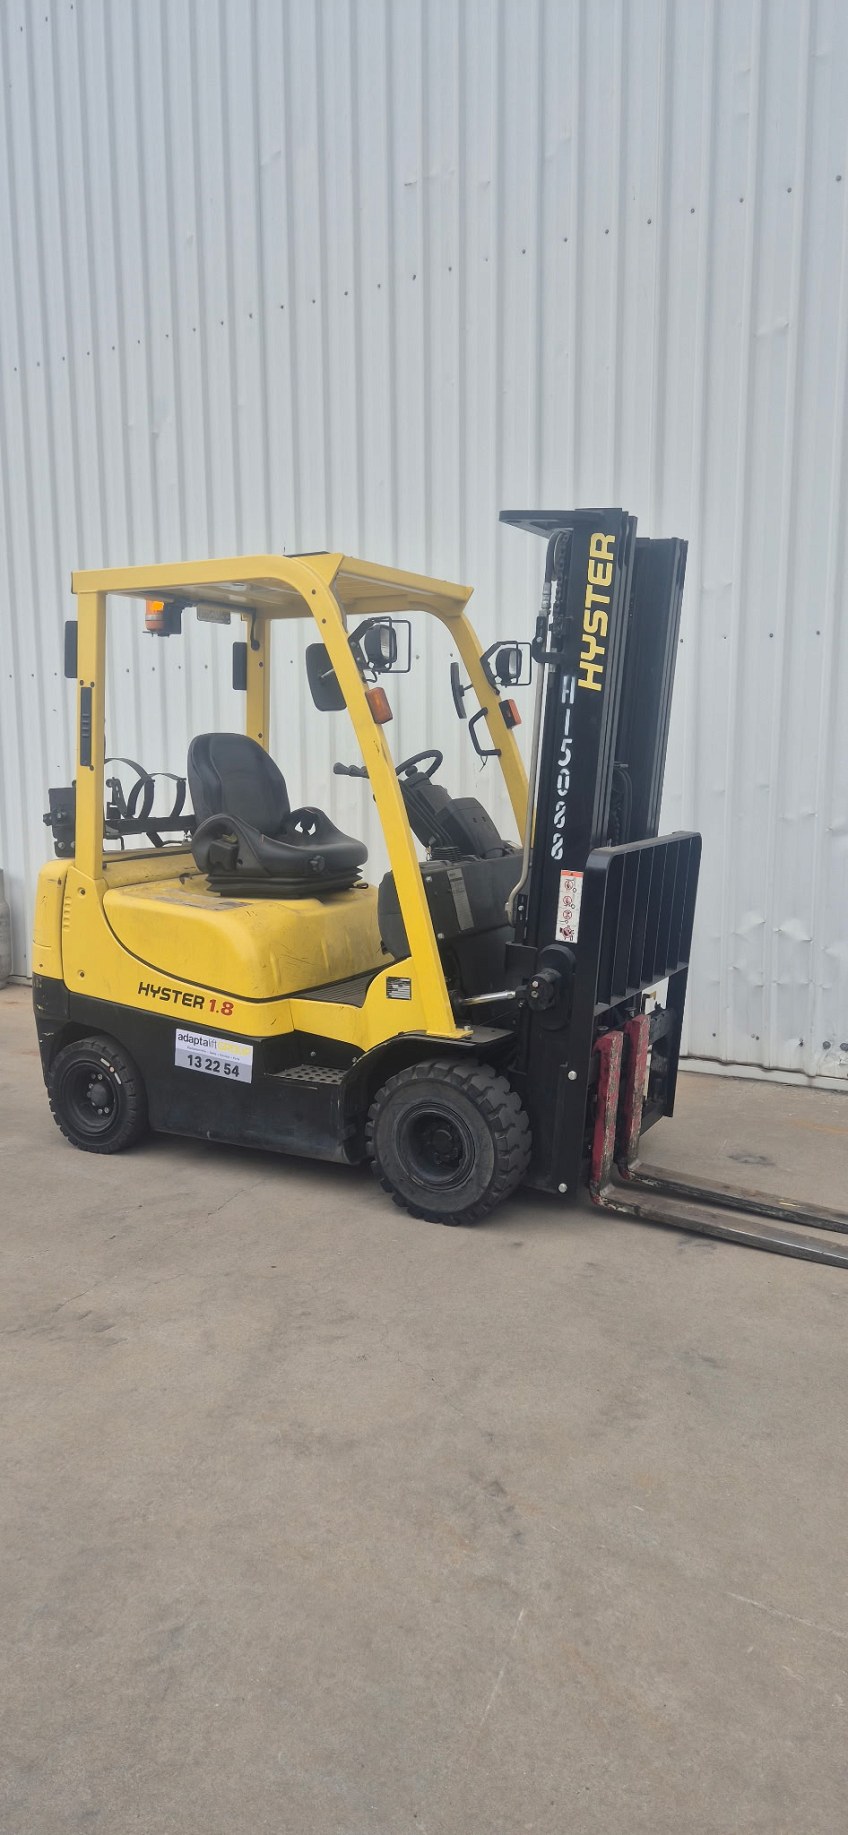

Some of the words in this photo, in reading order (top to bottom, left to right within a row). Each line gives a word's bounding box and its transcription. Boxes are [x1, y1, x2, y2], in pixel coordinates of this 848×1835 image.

[577, 532, 616, 692] HYSTER
[138, 981, 205, 1010] HYSTER
[209, 998, 234, 1016] 1.8
[187, 1054, 202, 1068] 13
[204, 1058, 221, 1073] 22
[223, 1063, 240, 1078] 54
